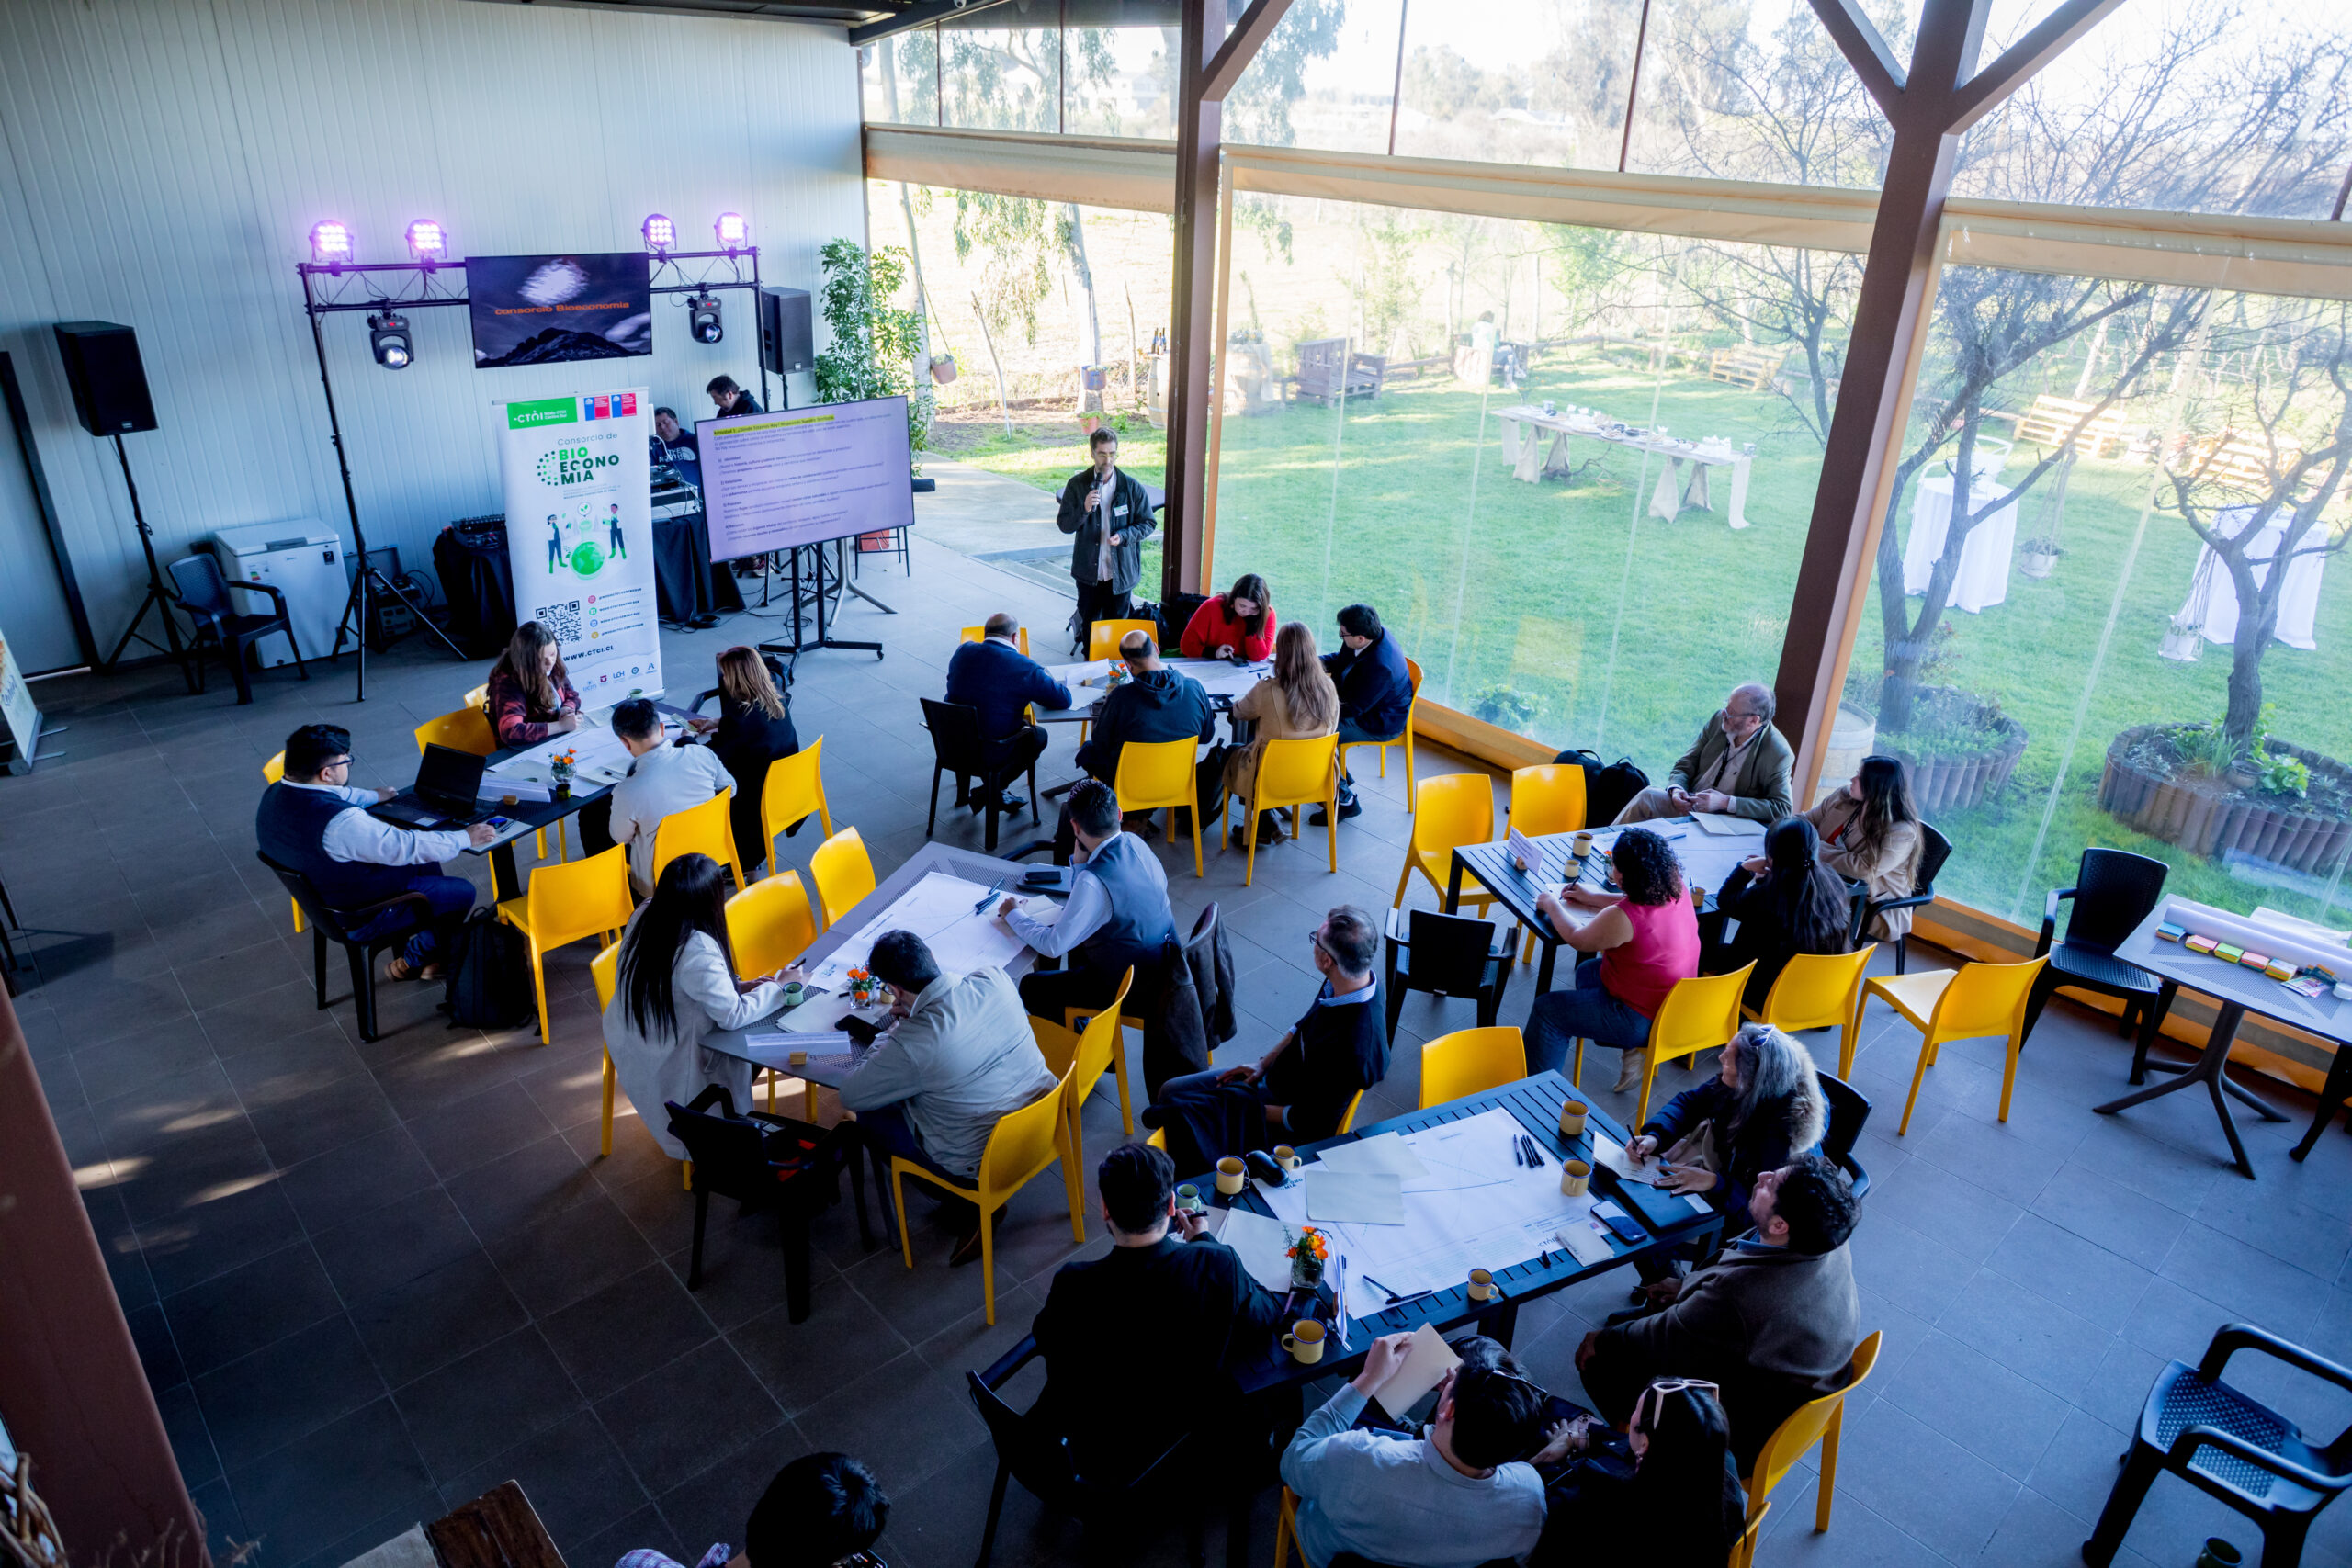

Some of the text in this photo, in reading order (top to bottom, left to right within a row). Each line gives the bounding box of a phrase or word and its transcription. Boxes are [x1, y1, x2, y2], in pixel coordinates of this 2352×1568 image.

[494, 305, 553, 316] consorcio
[557, 432, 618, 446] Consorcio de
[559, 446, 588, 461] BIO
[560, 454, 620, 473] ECONO
[561, 470, 594, 485] MIA
[563, 645, 614, 662] WWW.CTCI.CL
